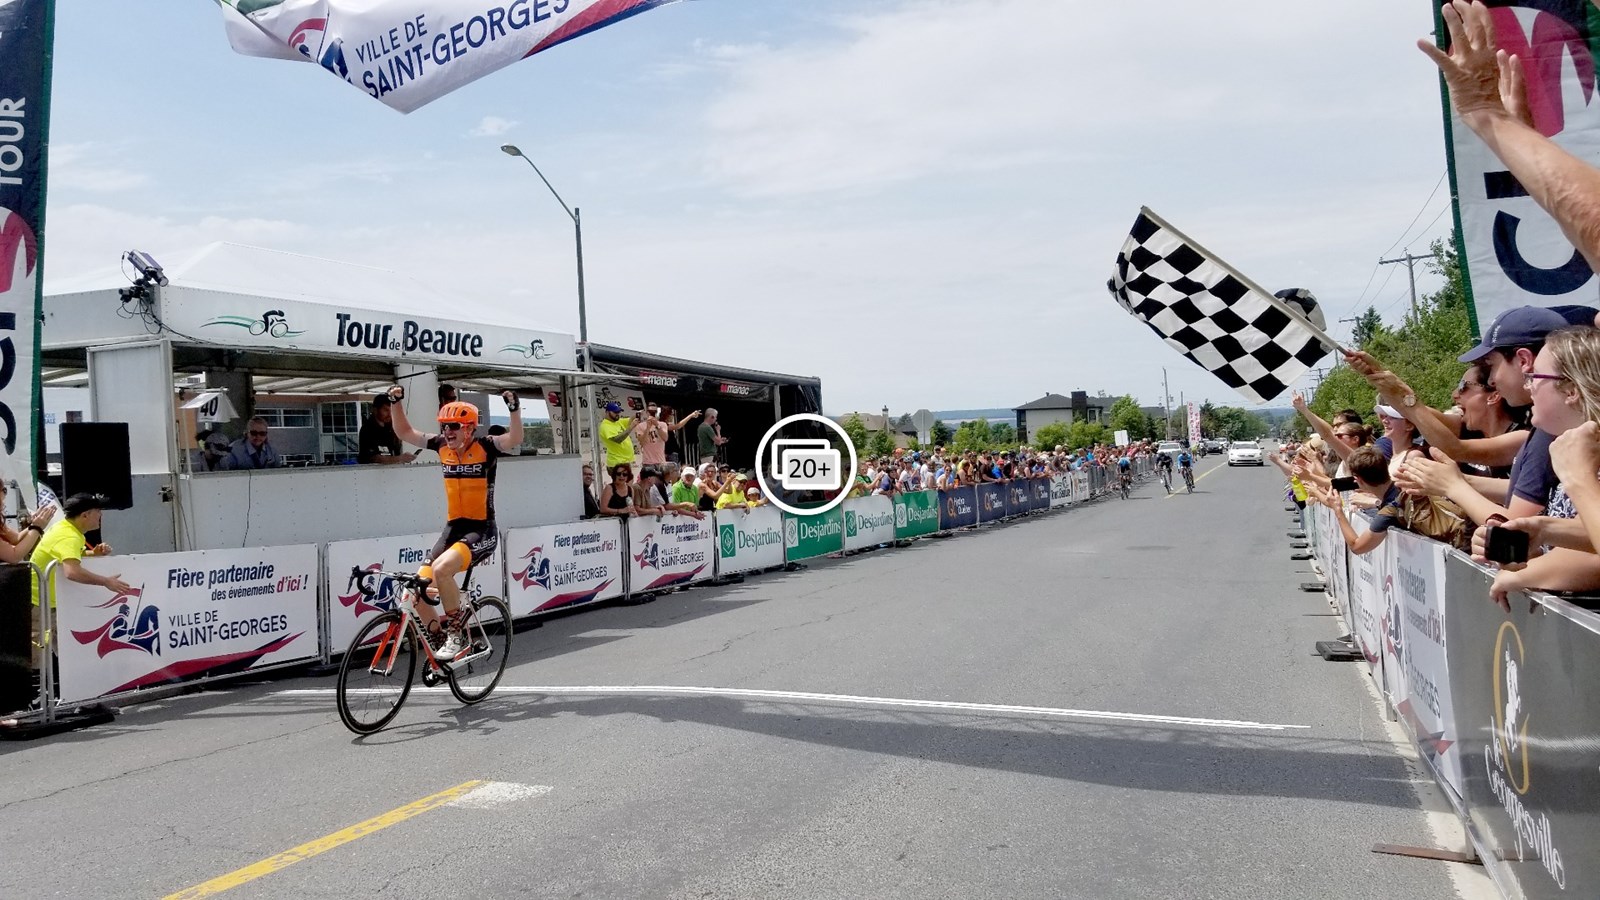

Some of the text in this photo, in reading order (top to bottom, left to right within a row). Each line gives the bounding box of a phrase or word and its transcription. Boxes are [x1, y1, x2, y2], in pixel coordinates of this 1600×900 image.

[355, 14, 428, 64] VILLE DE
[336, 313, 484, 358] Tour de Beauce
[200, 396, 219, 417] 40
[858, 509, 893, 532] Desjardins
[908, 505, 938, 527] Desjardins
[738, 528, 782, 552] Desjardins
[800, 519, 842, 542] Desjardins
[398, 547, 423, 564] Fière
[472, 536, 496, 552] SILBER
[167, 561, 275, 590] Fière partenaire
[554, 562, 569, 573] VILLE
[554, 565, 608, 587] SAINT-GEORGES
[211, 587, 227, 601] des
[228, 582, 275, 599] événements
[276, 575, 302, 594] d'ici
[168, 610, 219, 627] VILLE DE
[168, 614, 288, 649] SAINT-GEORGES
[1484, 744, 1566, 890] Georgesville
